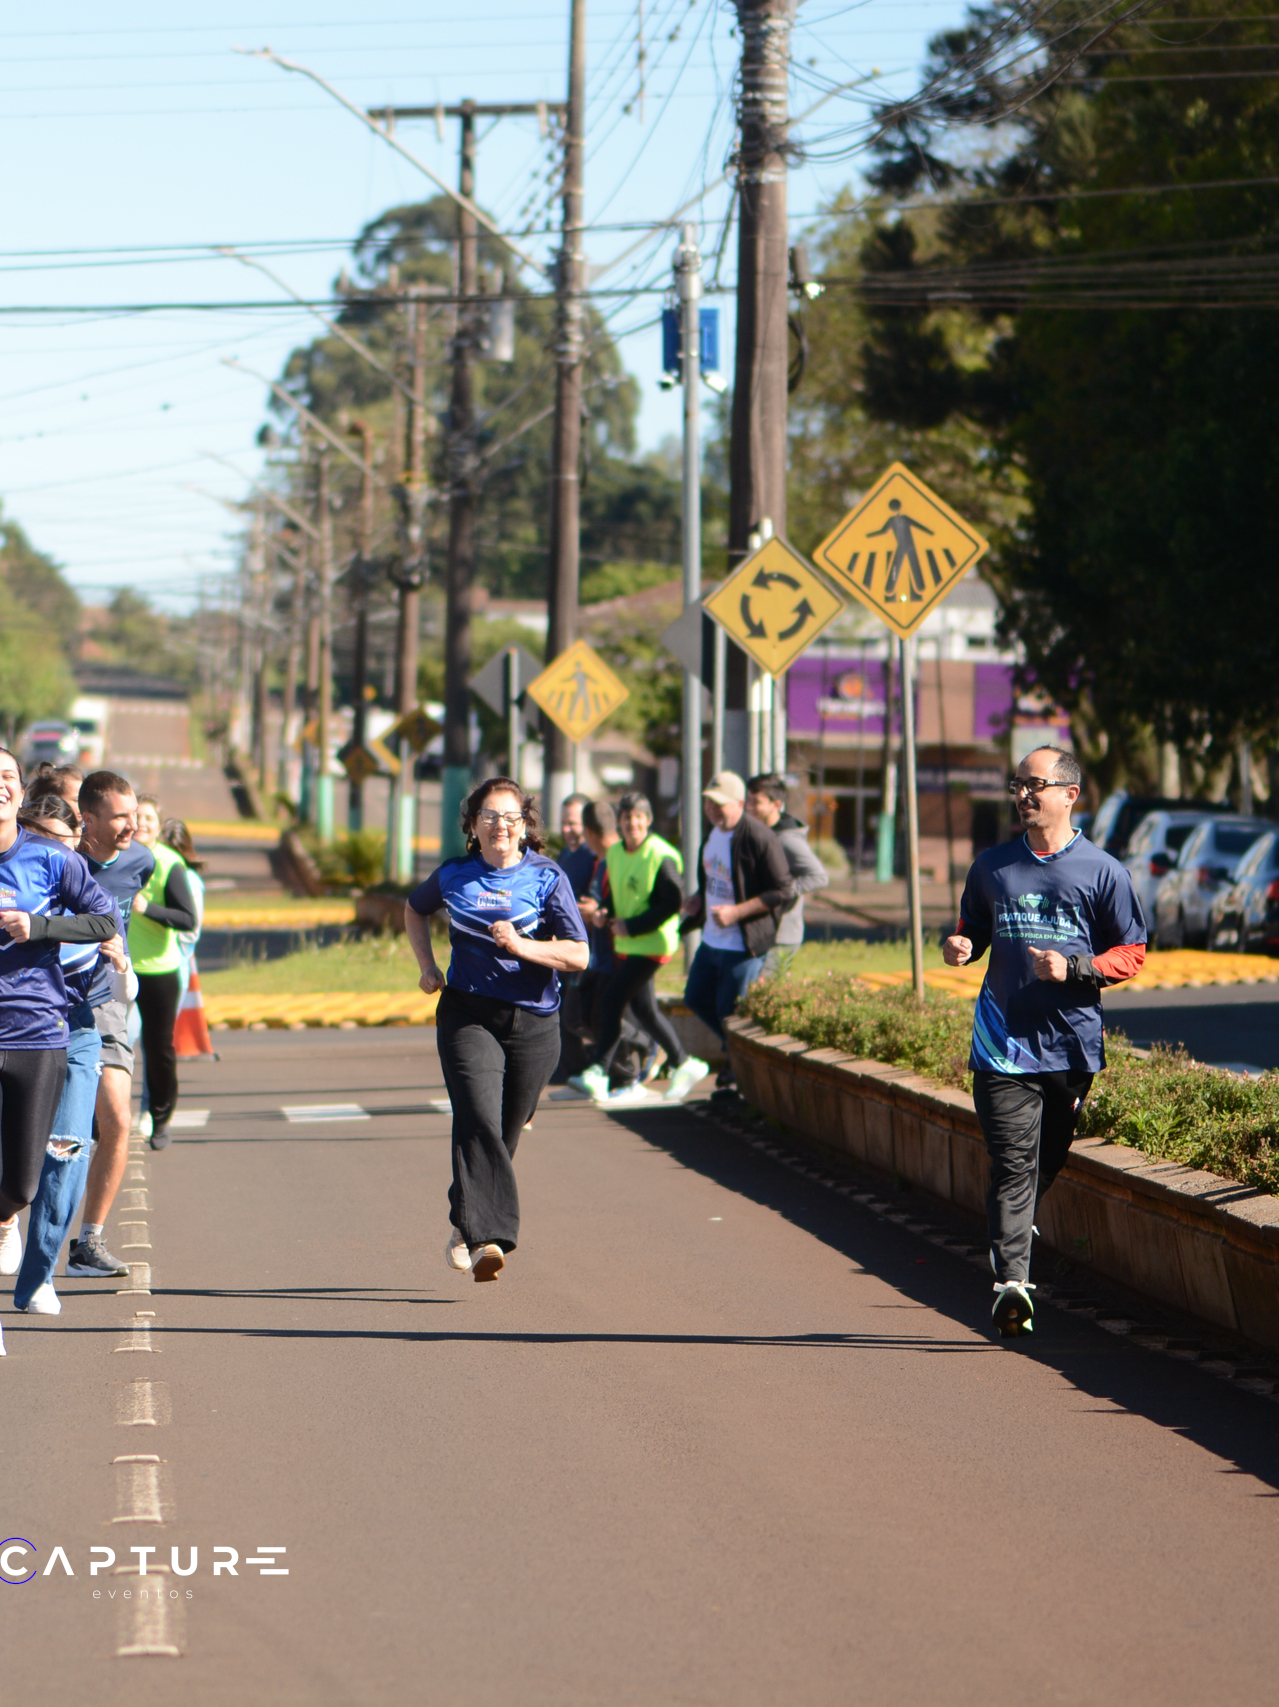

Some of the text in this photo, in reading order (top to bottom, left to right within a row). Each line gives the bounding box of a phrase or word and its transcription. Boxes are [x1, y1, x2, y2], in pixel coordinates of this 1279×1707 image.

[478, 896, 497, 907] ONG
[999, 912, 1071, 929] PRATIQUE AJUDA
